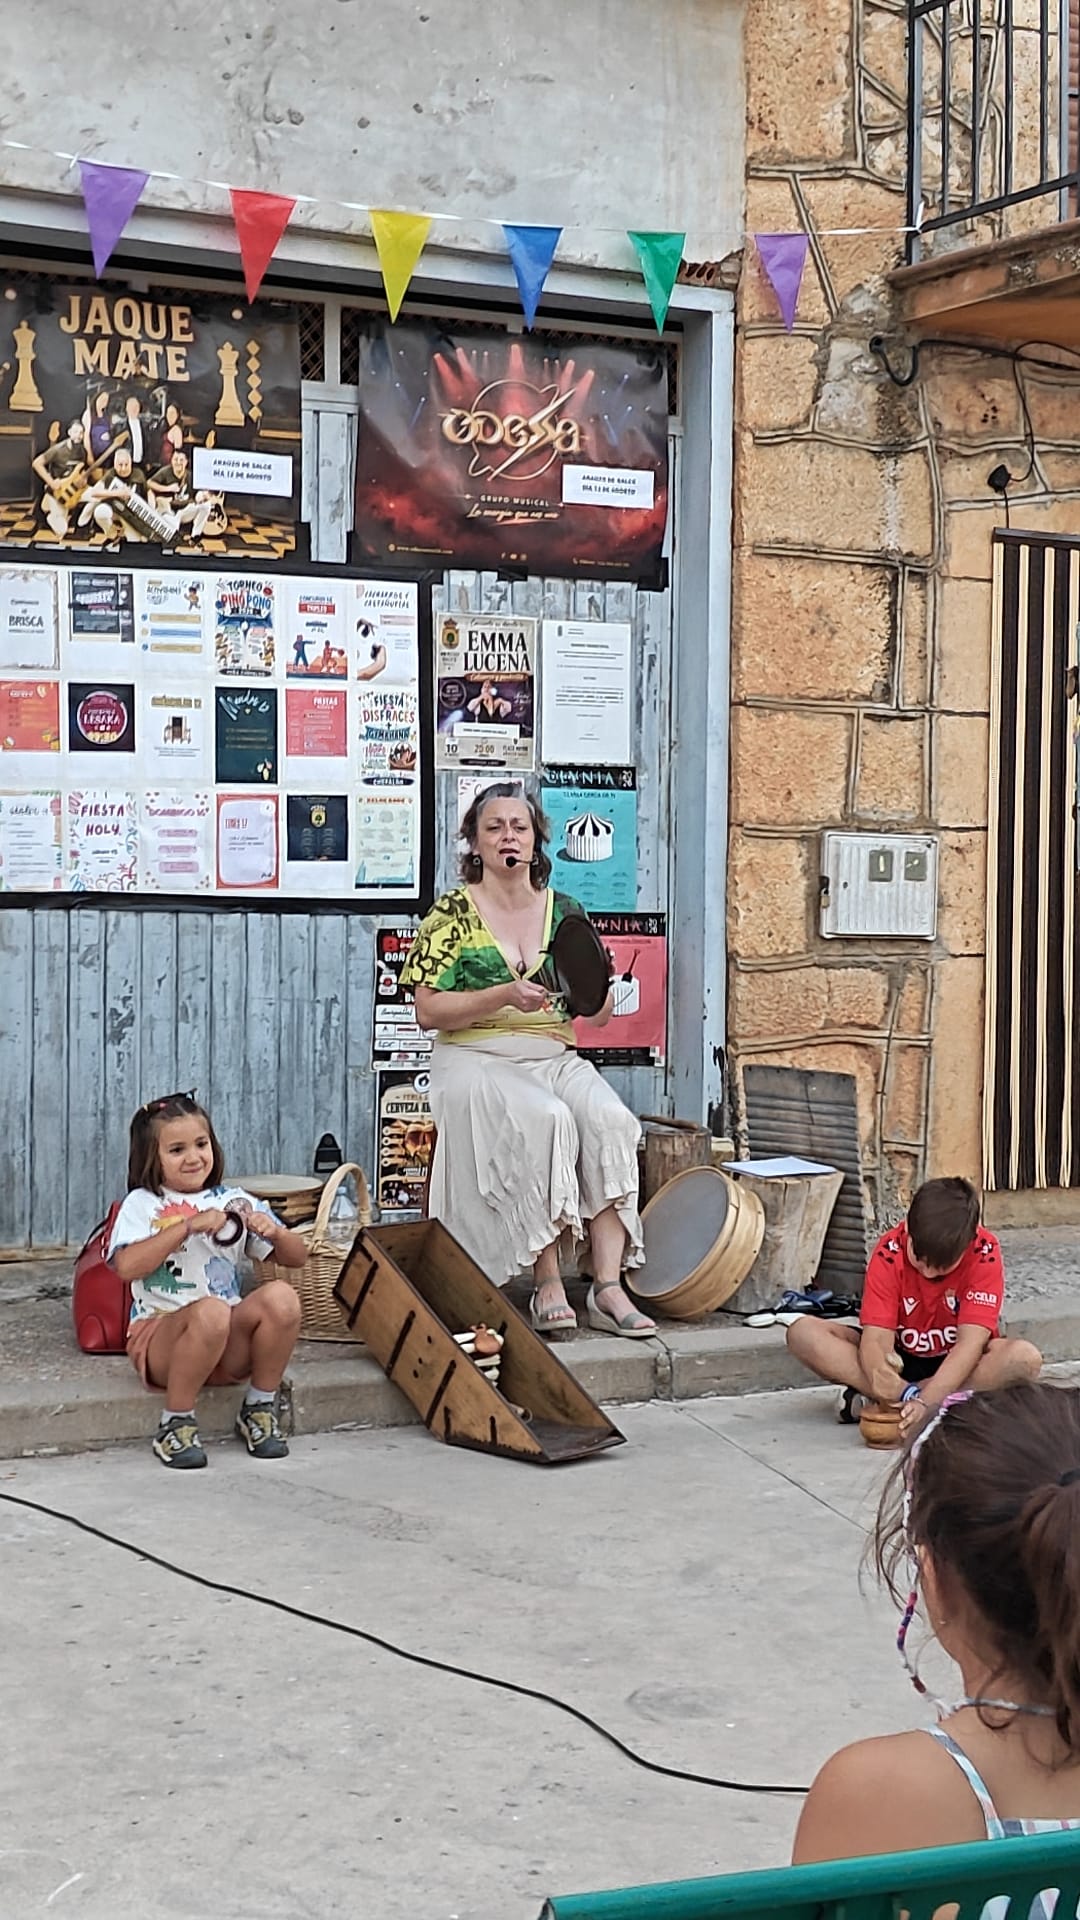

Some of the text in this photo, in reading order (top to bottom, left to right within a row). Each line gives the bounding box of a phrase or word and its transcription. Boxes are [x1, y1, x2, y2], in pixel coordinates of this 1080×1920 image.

[59, 295, 195, 343] JAQUE
[72, 338, 191, 382] MATE
[480, 494, 549, 507] GRUPO MUSICAL
[8, 615, 44, 627] BRISCA
[468, 630, 527, 652] EMMA
[464, 652, 530, 672] LUCENA
[374, 693, 404, 707] FIESTA
[363, 709, 415, 723] DISFRACES
[446, 743, 458, 753] 10
[81, 803, 124, 817] FIESTA
[85, 824, 120, 836] HOLY
[386, 1101, 419, 1113] CERVEZA
[898, 1325, 957, 1352] osne
